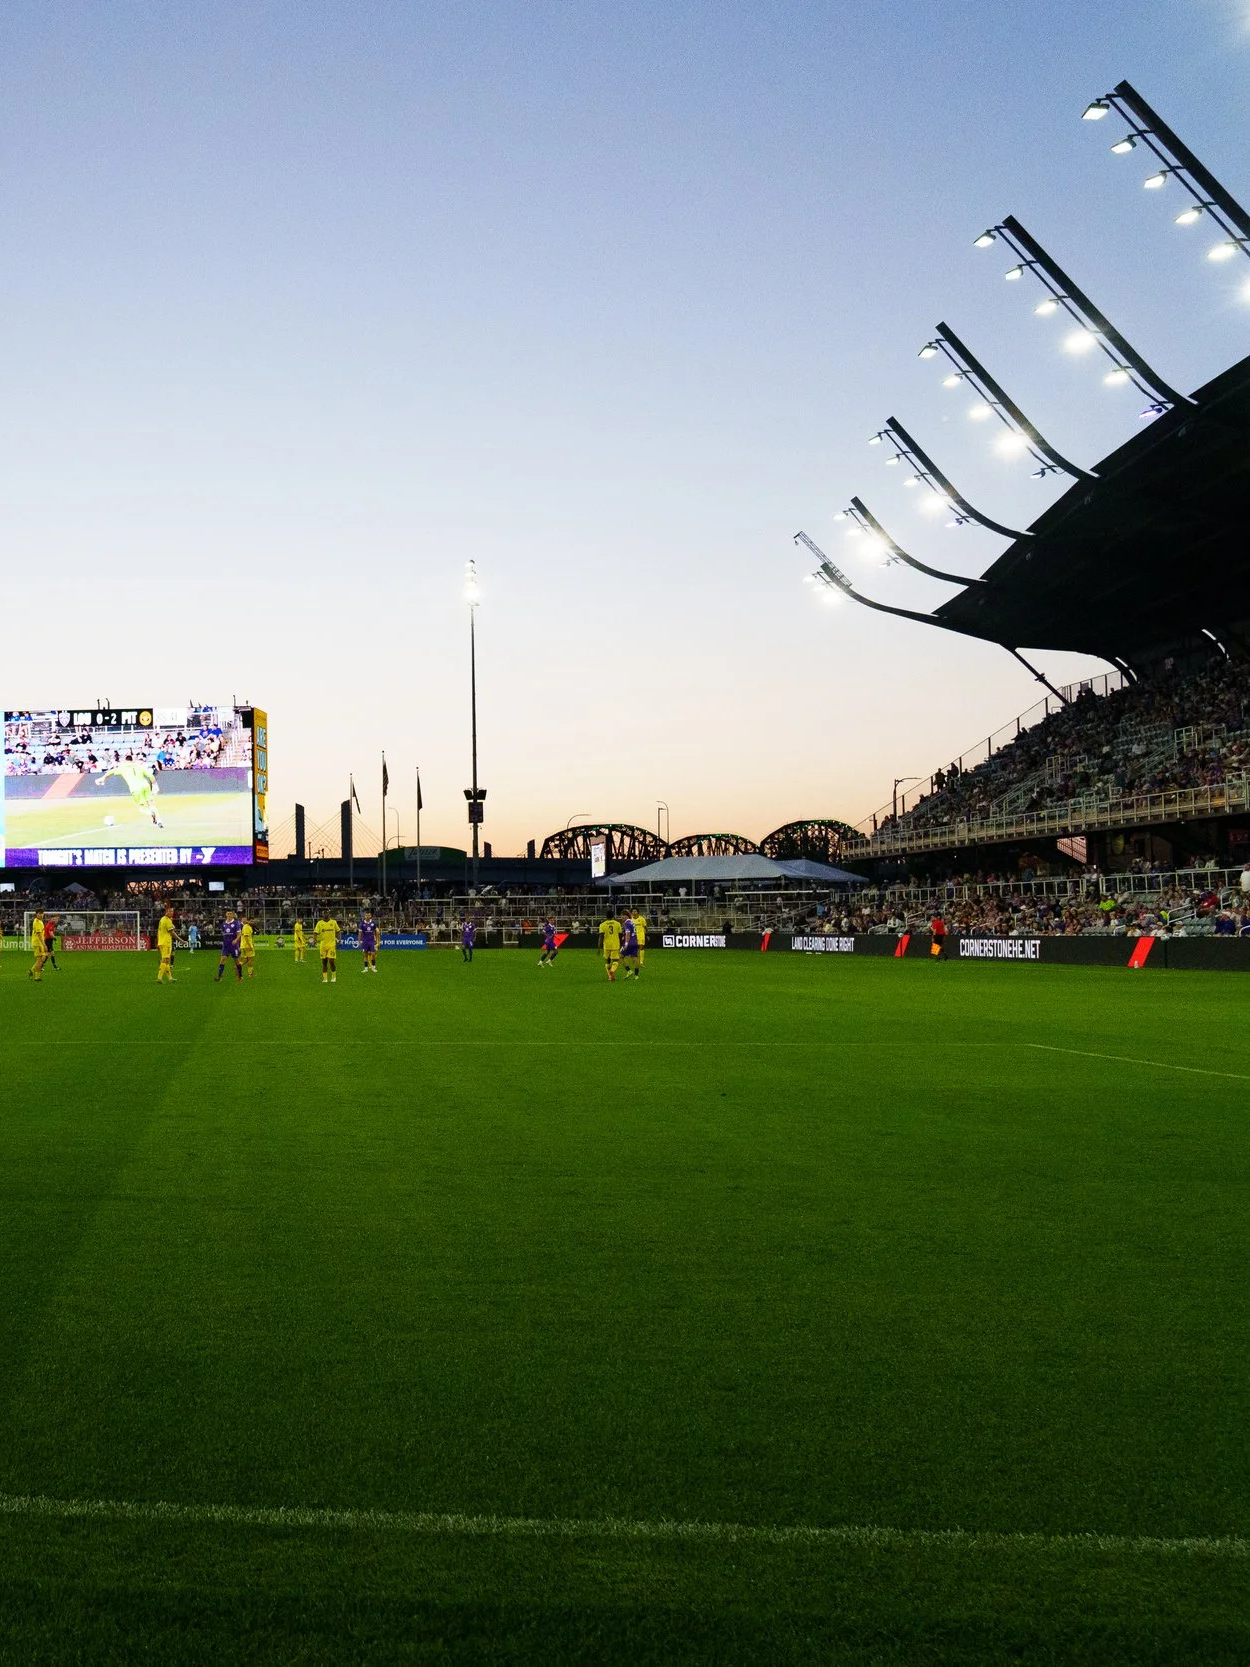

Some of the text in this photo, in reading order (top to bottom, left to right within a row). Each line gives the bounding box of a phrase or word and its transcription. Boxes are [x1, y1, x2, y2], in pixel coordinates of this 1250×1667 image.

[121, 711, 138, 724] PIT
[84, 849, 115, 865] MATCH
[117, 849, 126, 864] IS
[128, 848, 177, 864] PRESENTED
[180, 848, 192, 864] BY
[608, 925, 614, 935] 3
[75, 936, 137, 945] JEFFERSON
[791, 936, 854, 952] LAND CLEARING DONE RIGHT
[959, 938, 1041, 959] CORNERSTONEHE.NET
